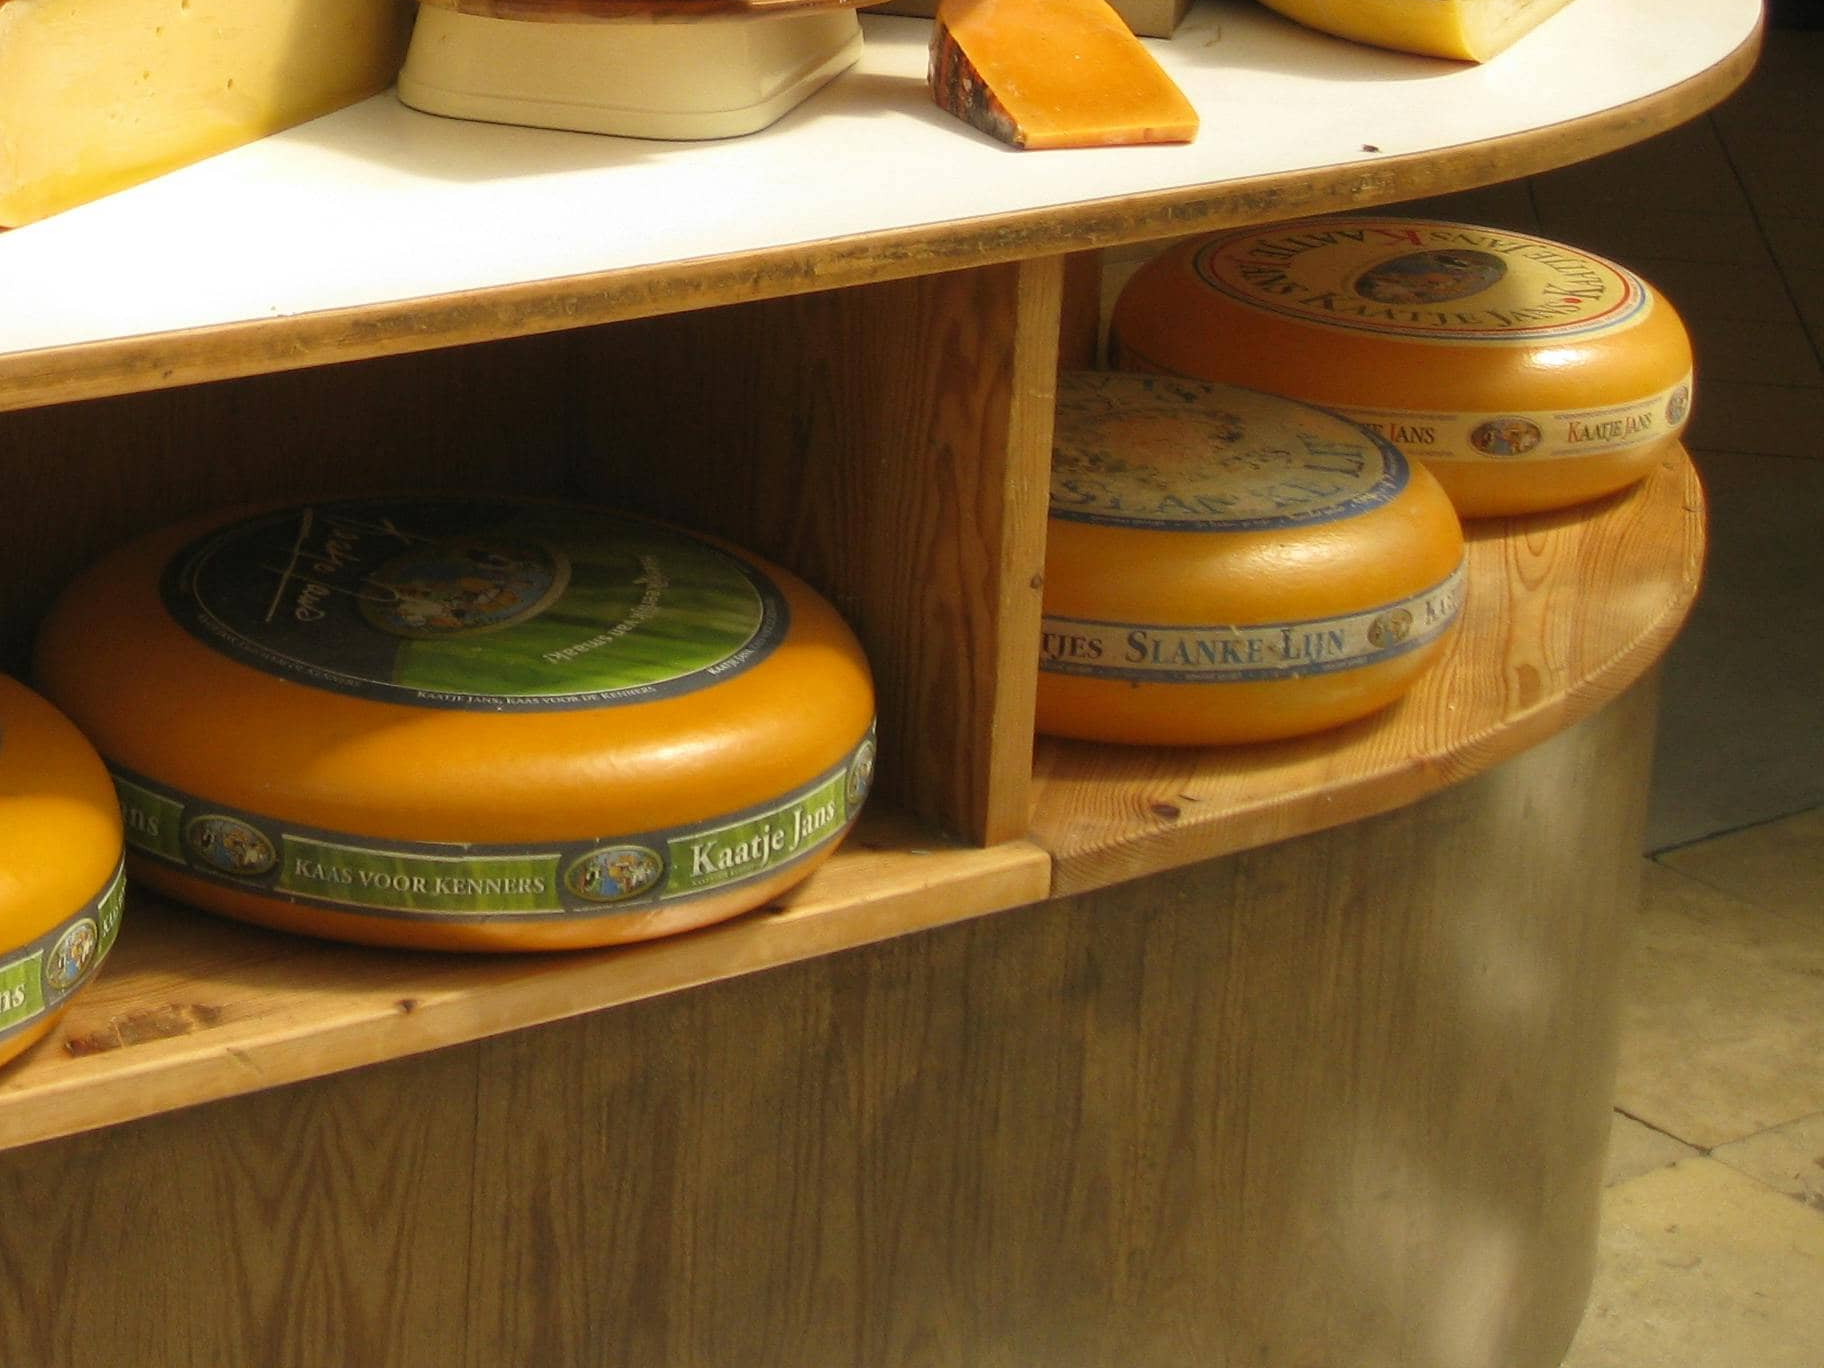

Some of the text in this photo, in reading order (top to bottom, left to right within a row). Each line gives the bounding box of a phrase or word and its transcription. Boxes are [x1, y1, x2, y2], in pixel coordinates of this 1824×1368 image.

[1042, 628, 1345, 666] TJES SLANKE LIJN
[690, 798, 837, 879] Kaatje Jans
[295, 857, 545, 896] KAAS VOOR KENNERS
